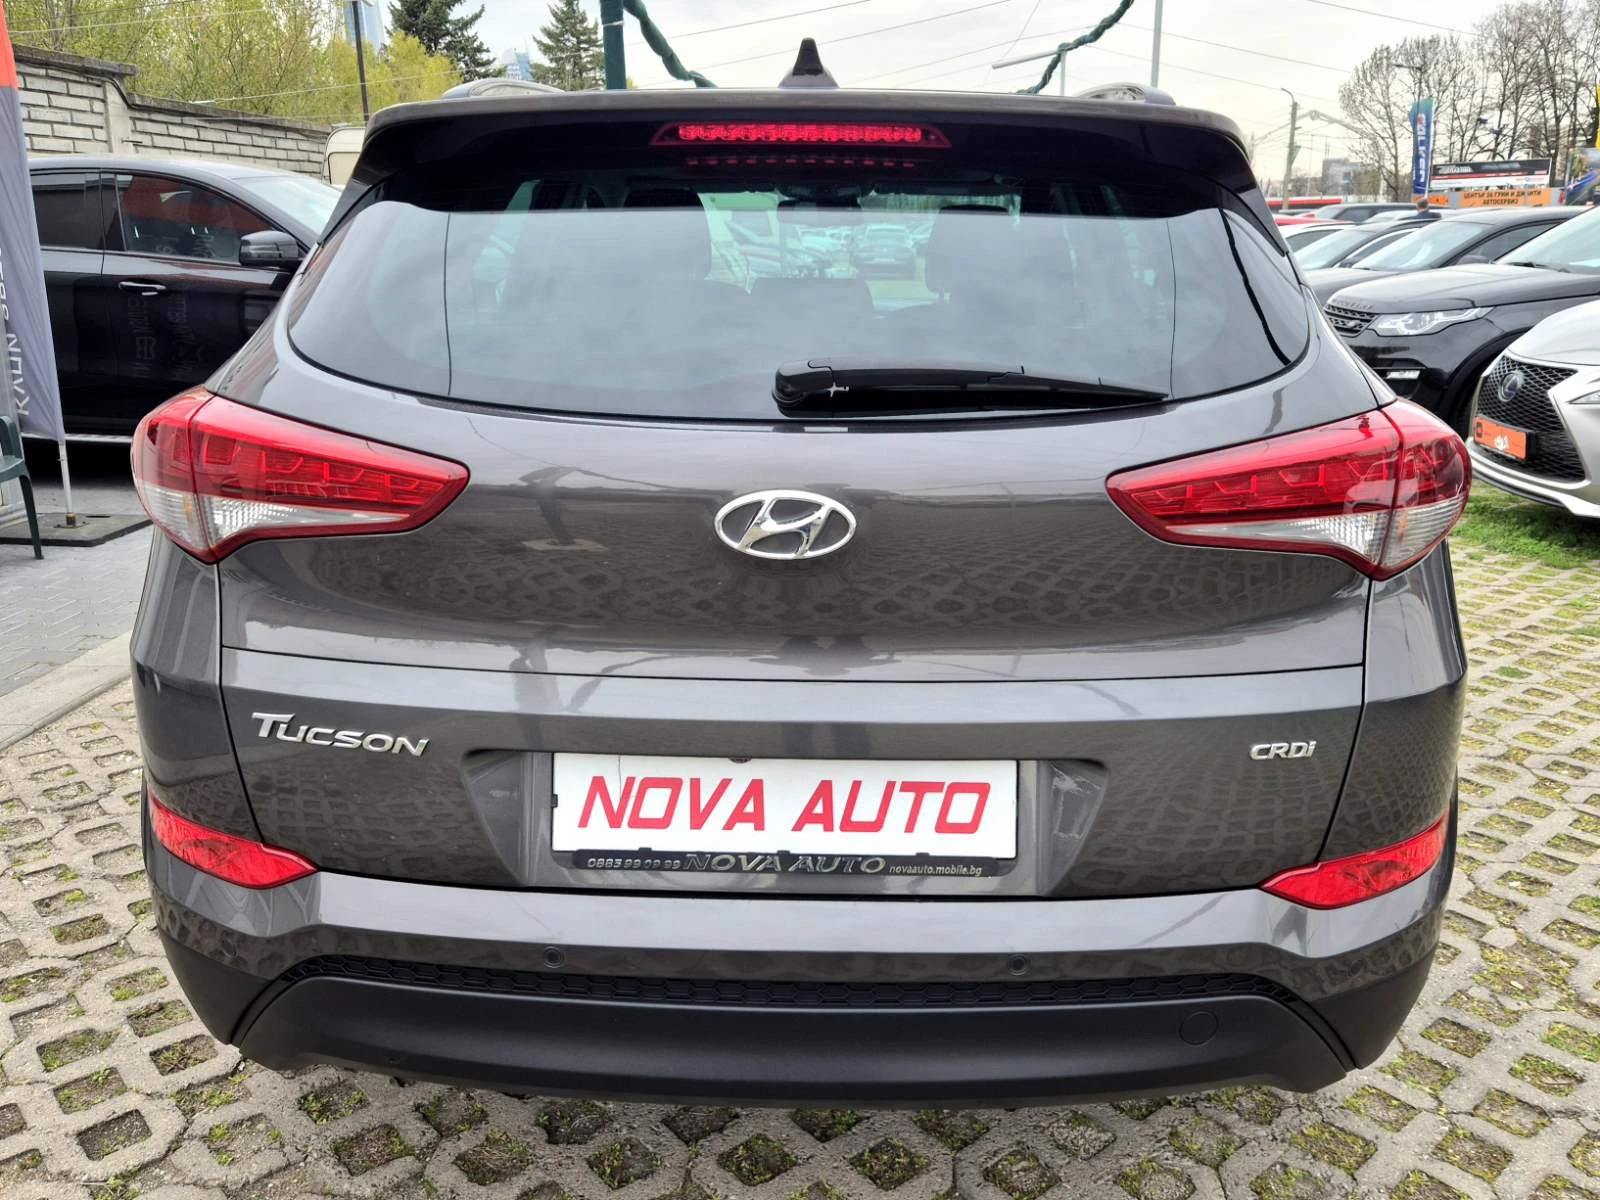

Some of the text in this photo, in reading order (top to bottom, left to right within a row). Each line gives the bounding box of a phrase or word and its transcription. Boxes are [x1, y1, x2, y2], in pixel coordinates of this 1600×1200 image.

[251, 711, 430, 757] TUCSON
[1250, 740, 1317, 760] CRDi
[577, 775, 992, 835] NOVA AUTO
[683, 853, 782, 872] NOVA
[788, 855, 887, 874] AUTO
[889, 864, 984, 877] novaauto.mobile.bg
